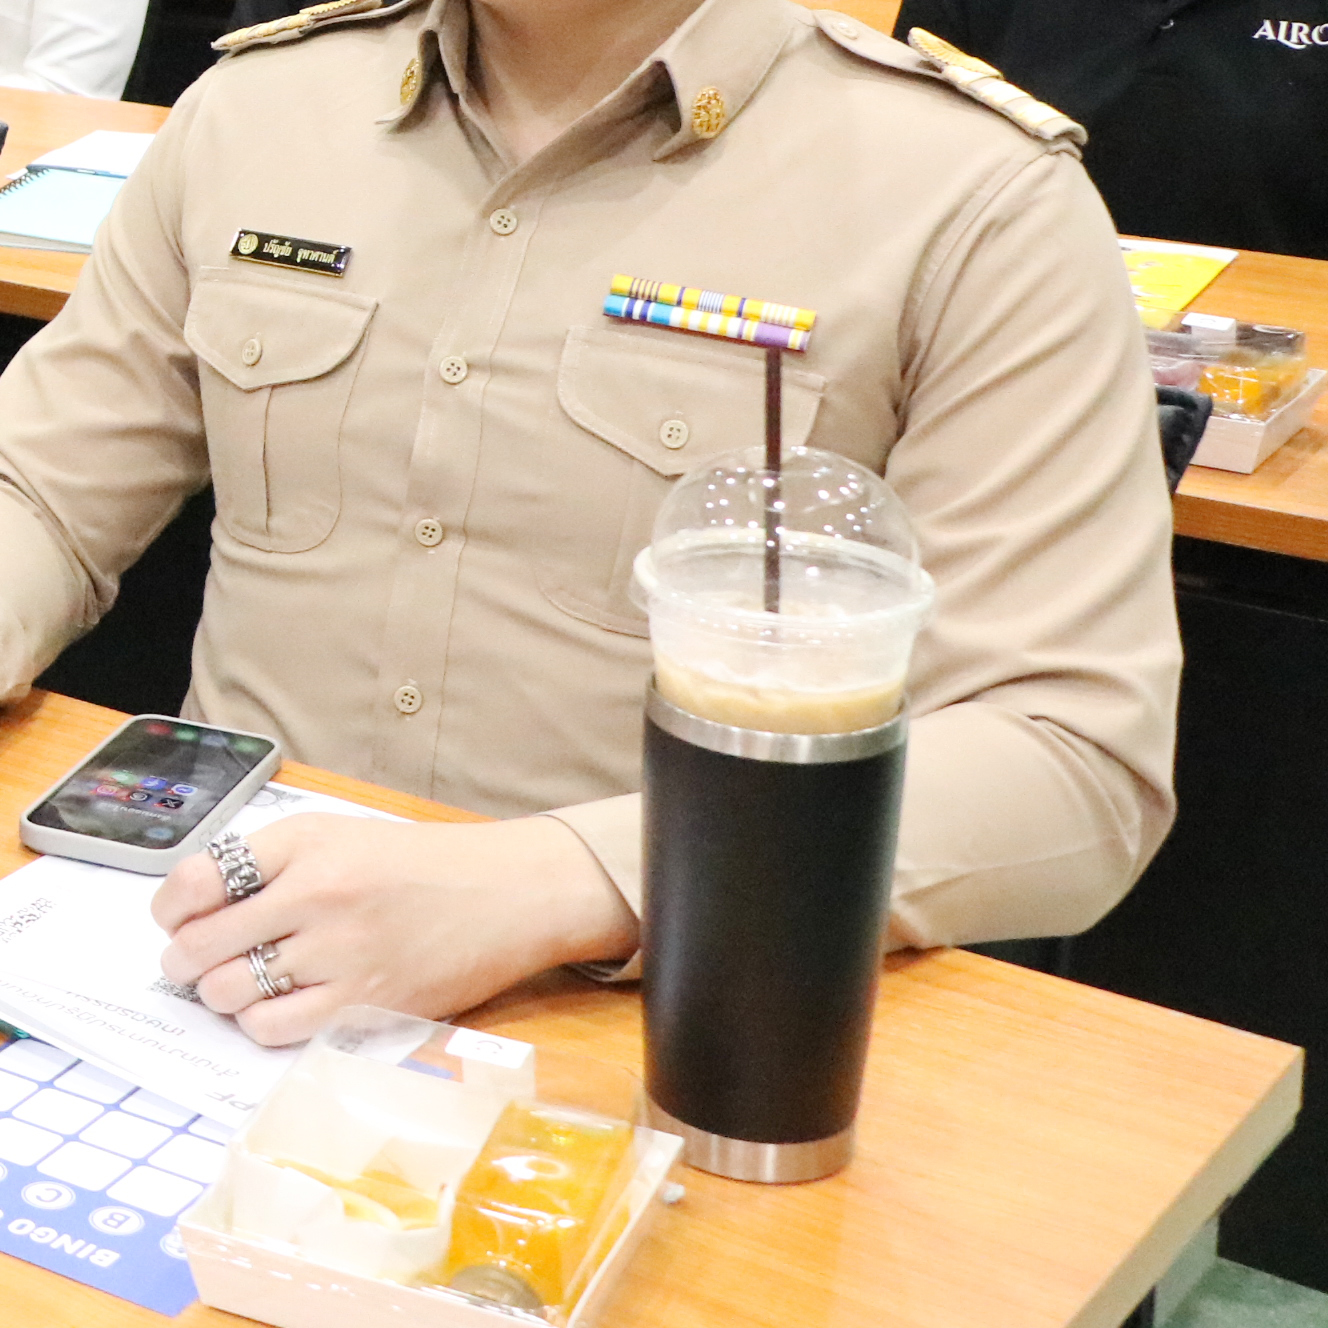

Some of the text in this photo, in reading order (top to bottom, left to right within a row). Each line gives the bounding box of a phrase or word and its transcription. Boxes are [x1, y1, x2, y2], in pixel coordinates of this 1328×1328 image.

[34, 1187, 64, 1204] C
[101, 1211, 132, 1230] B
[7, 1218, 122, 1268] BINGO
